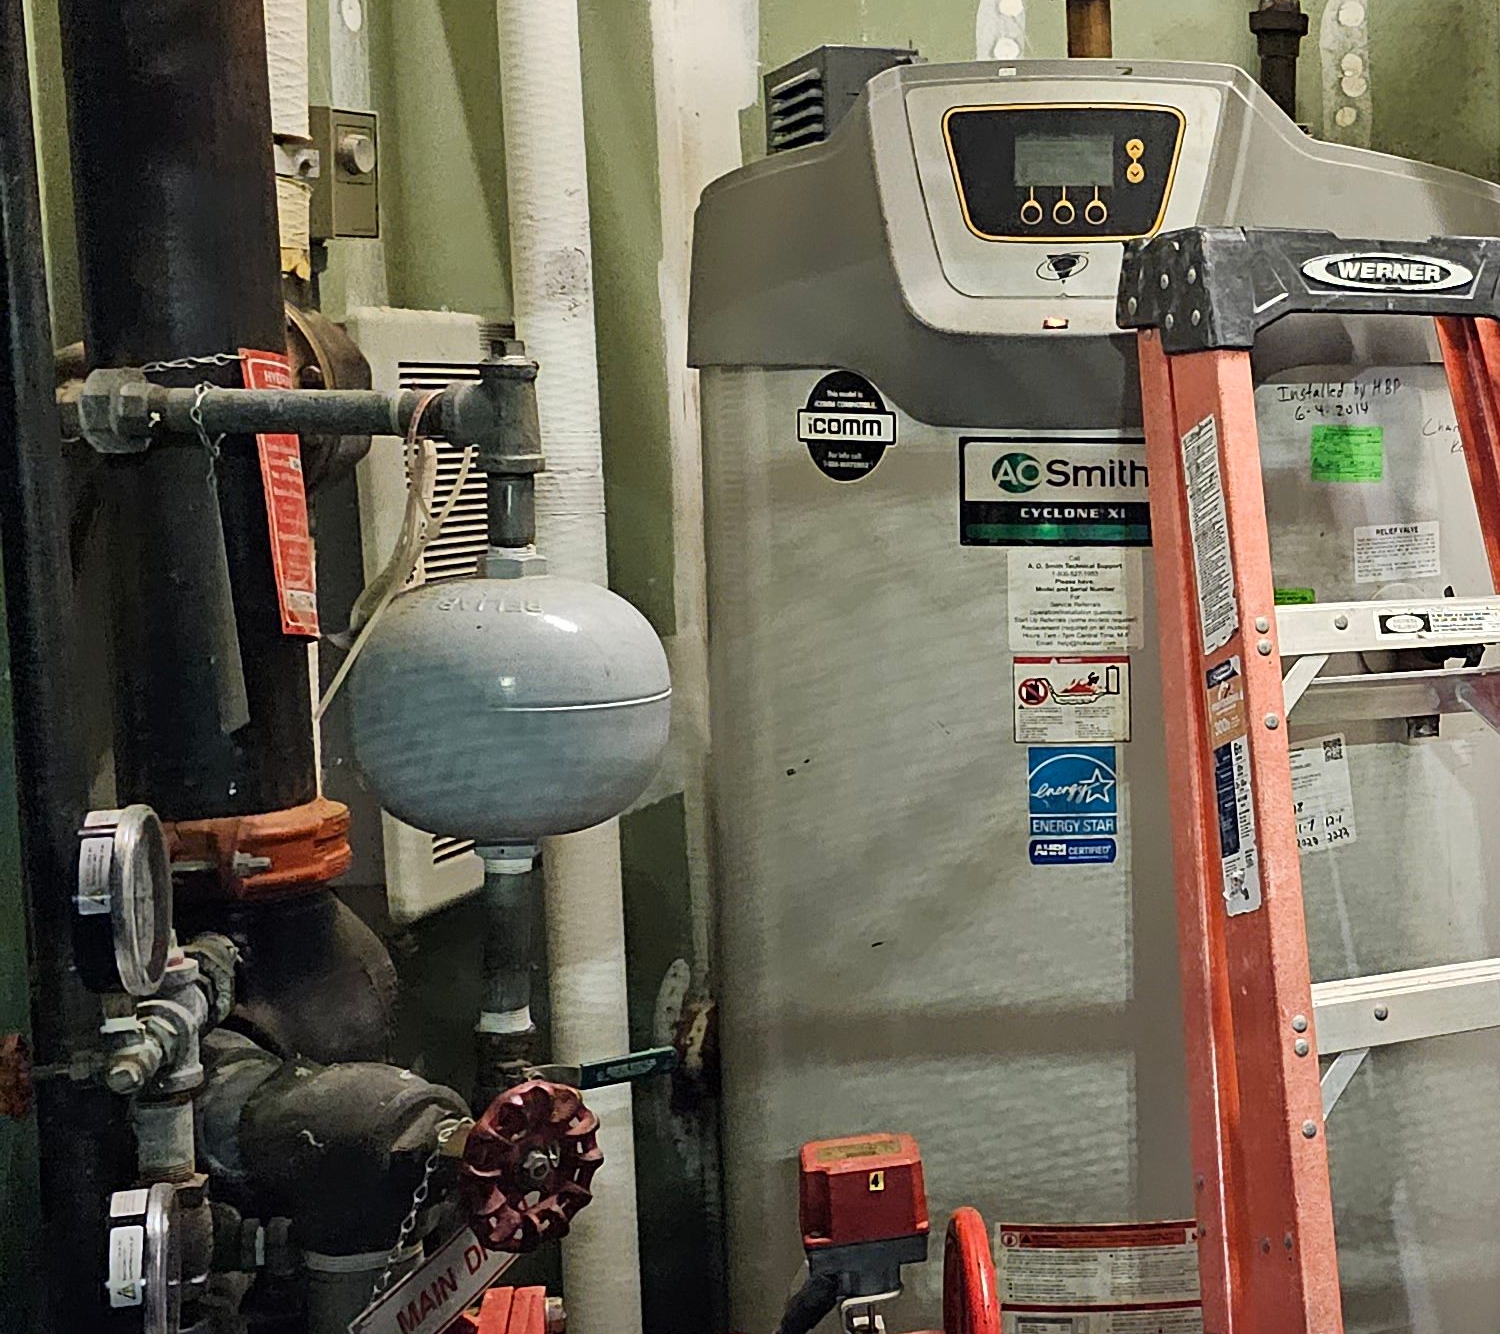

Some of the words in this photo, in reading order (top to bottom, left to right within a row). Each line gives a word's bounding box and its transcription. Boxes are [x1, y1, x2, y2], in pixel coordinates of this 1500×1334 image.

[1337, 260, 1442, 282] WERNER
[1277, 381, 1344, 403] Installed
[1353, 380, 1366, 395] by
[1045, 458, 1149, 488] Smith
[1020, 506, 1099, 519] CYCLONE
[1375, 526, 1399, 536] RELIEF
[1399, 525, 1419, 534] VALVE
[1032, 819, 1080, 833] ENERGY
[1083, 818, 1114, 833] STAR
[870, 1173, 880, 1188] 4
